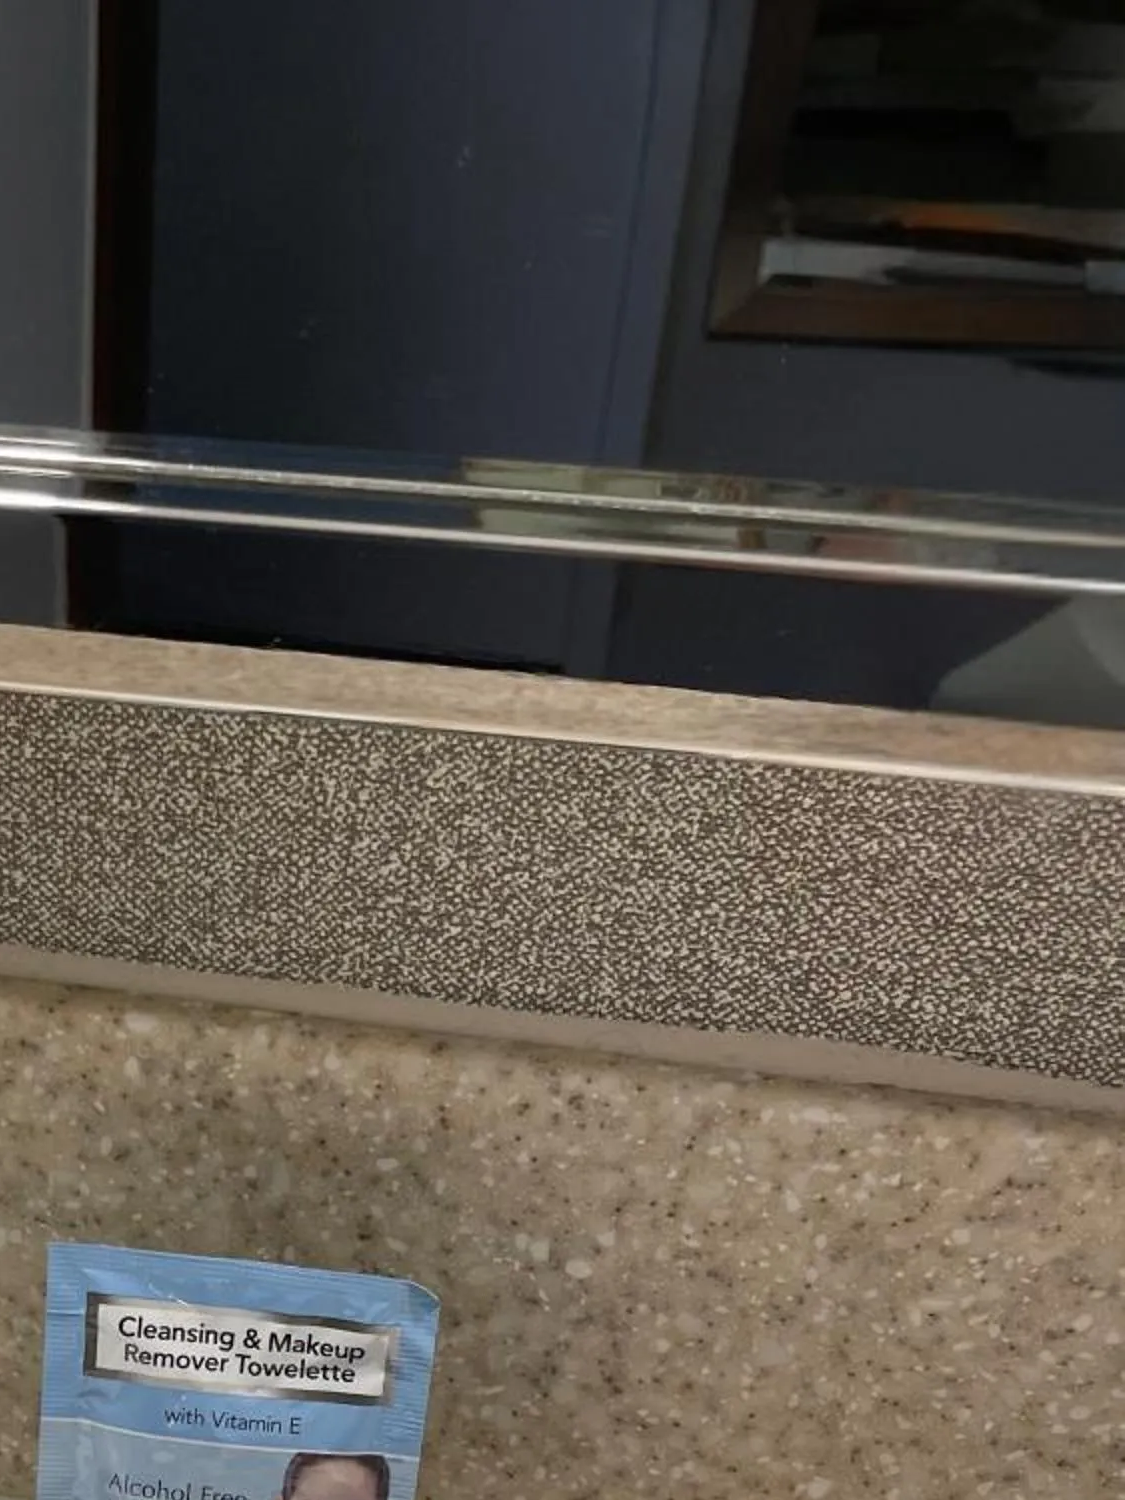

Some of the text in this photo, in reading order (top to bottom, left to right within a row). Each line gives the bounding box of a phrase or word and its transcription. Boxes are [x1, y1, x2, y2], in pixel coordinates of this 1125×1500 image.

[118, 1316, 366, 1364] Cleansing & Makeup
[124, 1343, 357, 1384] Remover Towelette
[164, 1406, 303, 1435] with Vitamin E
